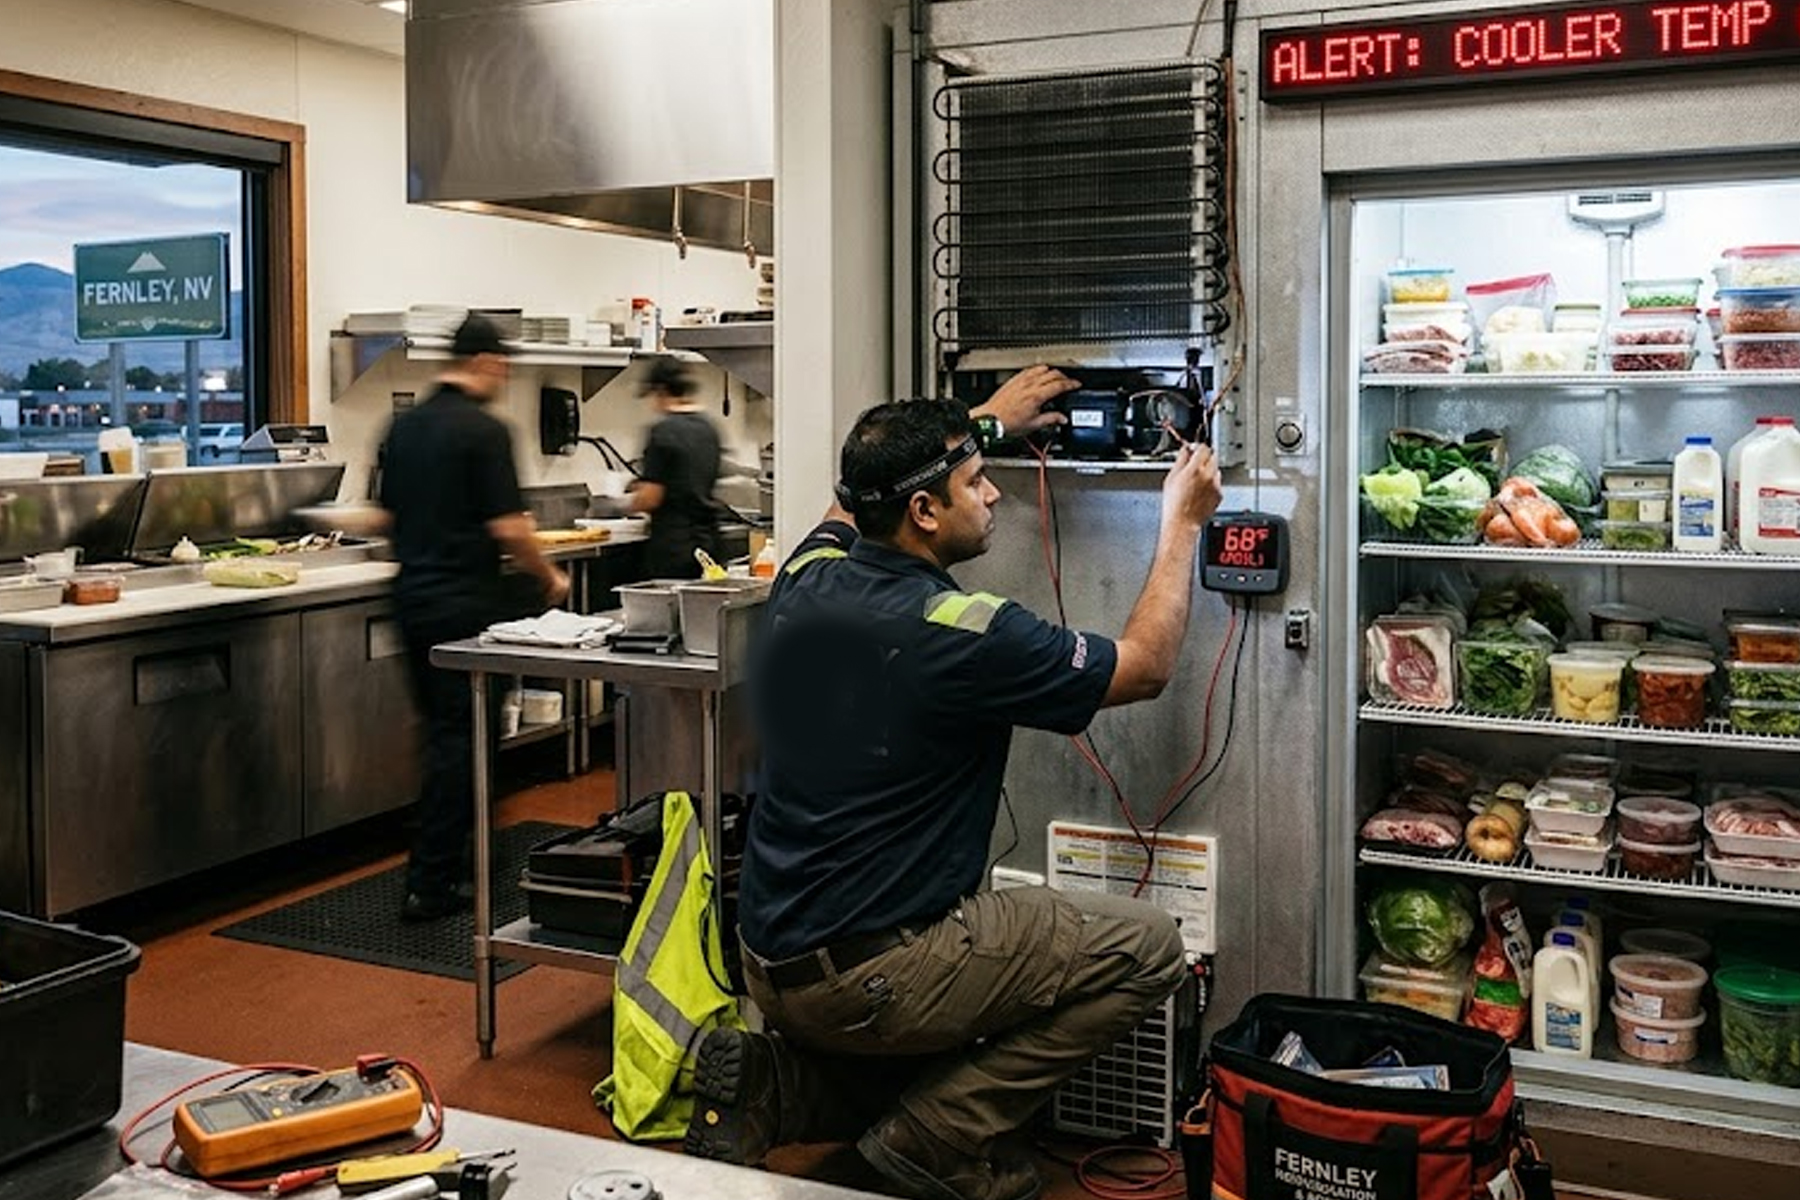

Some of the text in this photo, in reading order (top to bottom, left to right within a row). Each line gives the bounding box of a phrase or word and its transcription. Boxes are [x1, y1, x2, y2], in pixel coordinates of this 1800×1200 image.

[1273, 0, 1771, 83] ALERT: COOLER TEMP
[83, 275, 213, 306] FERNLEY, NV
[1274, 1147, 1378, 1189] FERNLEY
